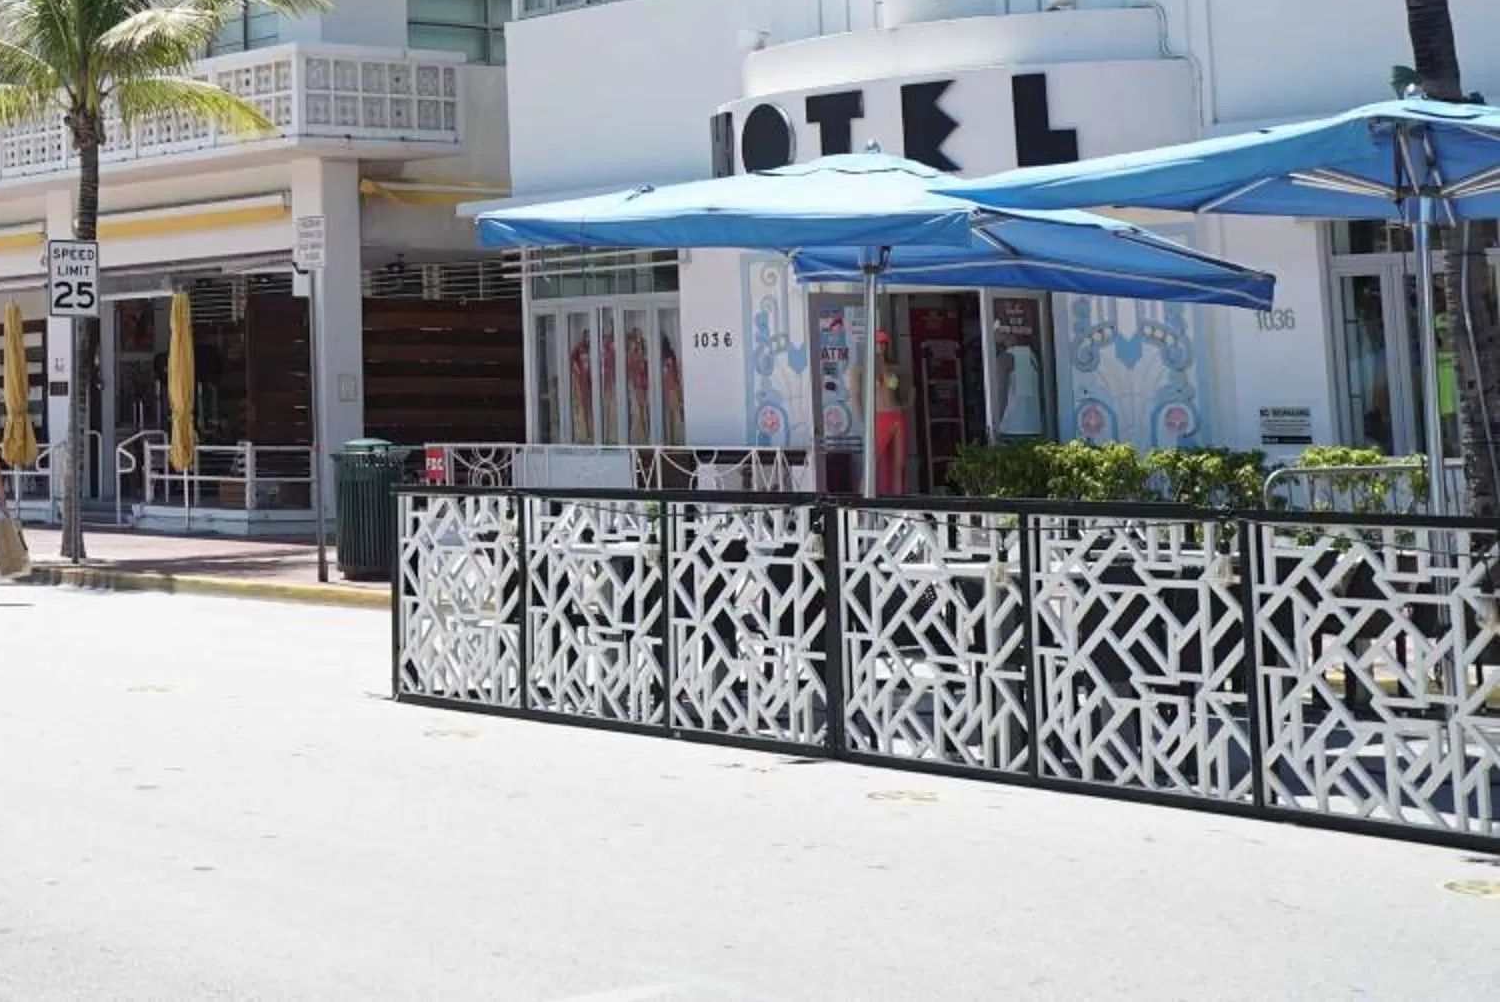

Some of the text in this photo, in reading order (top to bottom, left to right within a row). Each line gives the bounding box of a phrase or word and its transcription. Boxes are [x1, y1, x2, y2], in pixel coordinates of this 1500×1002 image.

[711, 72, 1080, 179] HOTEL
[53, 248, 95, 260] SPEED
[57, 265, 90, 276] LIMIT
[54, 281, 95, 308] 25
[1254, 308, 1297, 331] 1036
[694, 331, 733, 348] 1036
